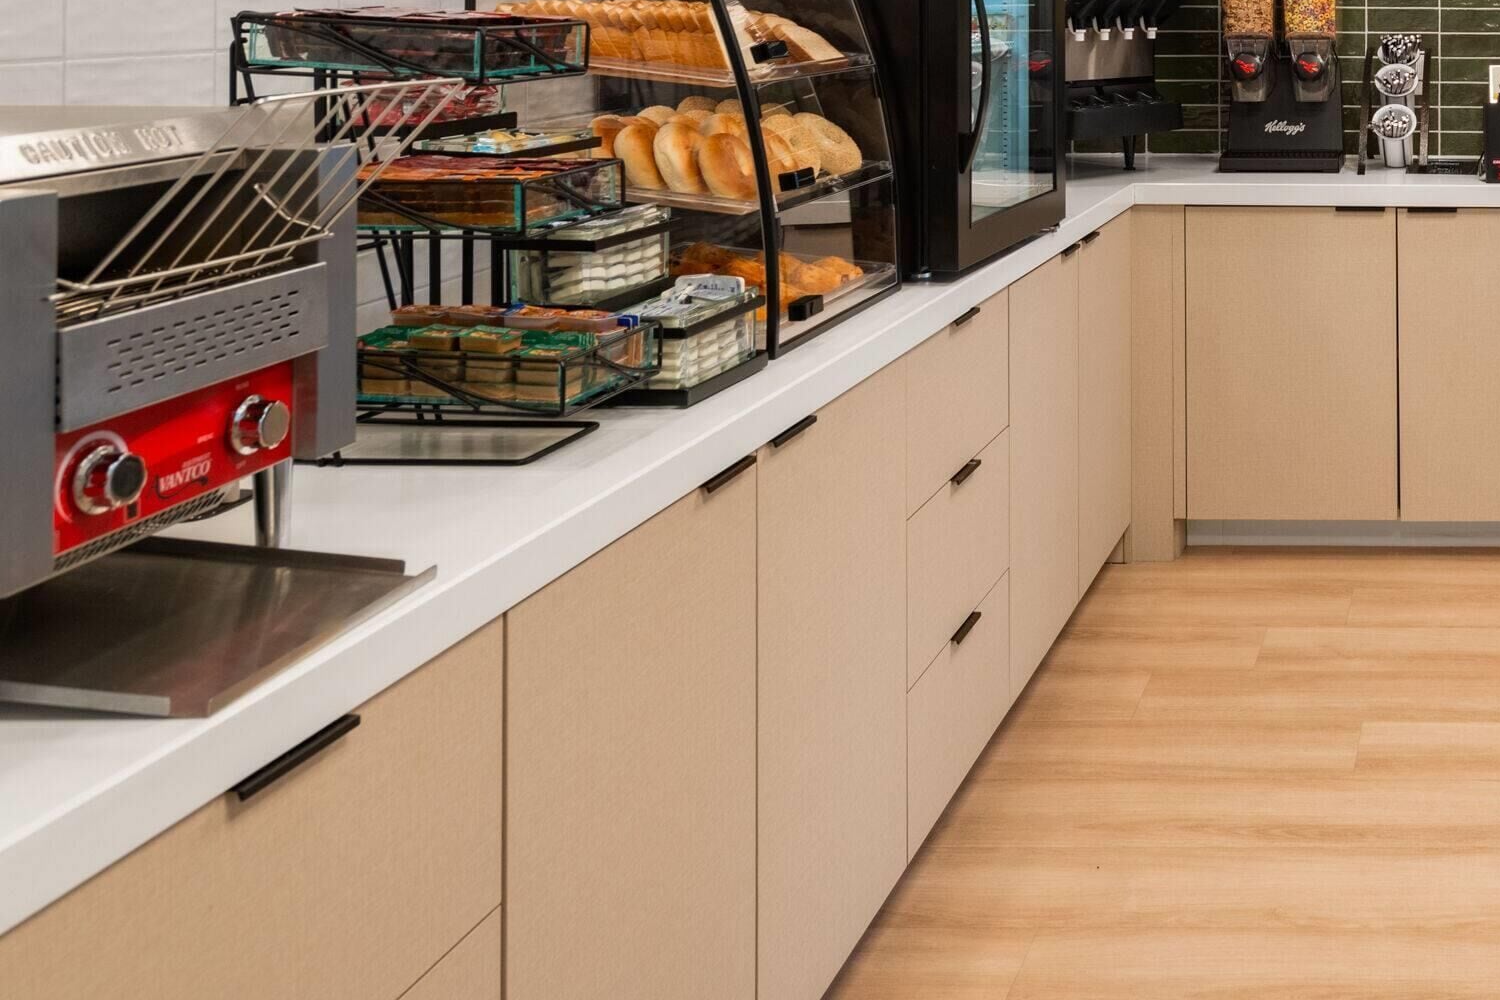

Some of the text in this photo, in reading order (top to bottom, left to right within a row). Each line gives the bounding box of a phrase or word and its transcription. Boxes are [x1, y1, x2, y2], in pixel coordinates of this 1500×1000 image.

[1264, 120, 1306, 136] Kellogg's
[18, 125, 183, 165] CAUTION HOT
